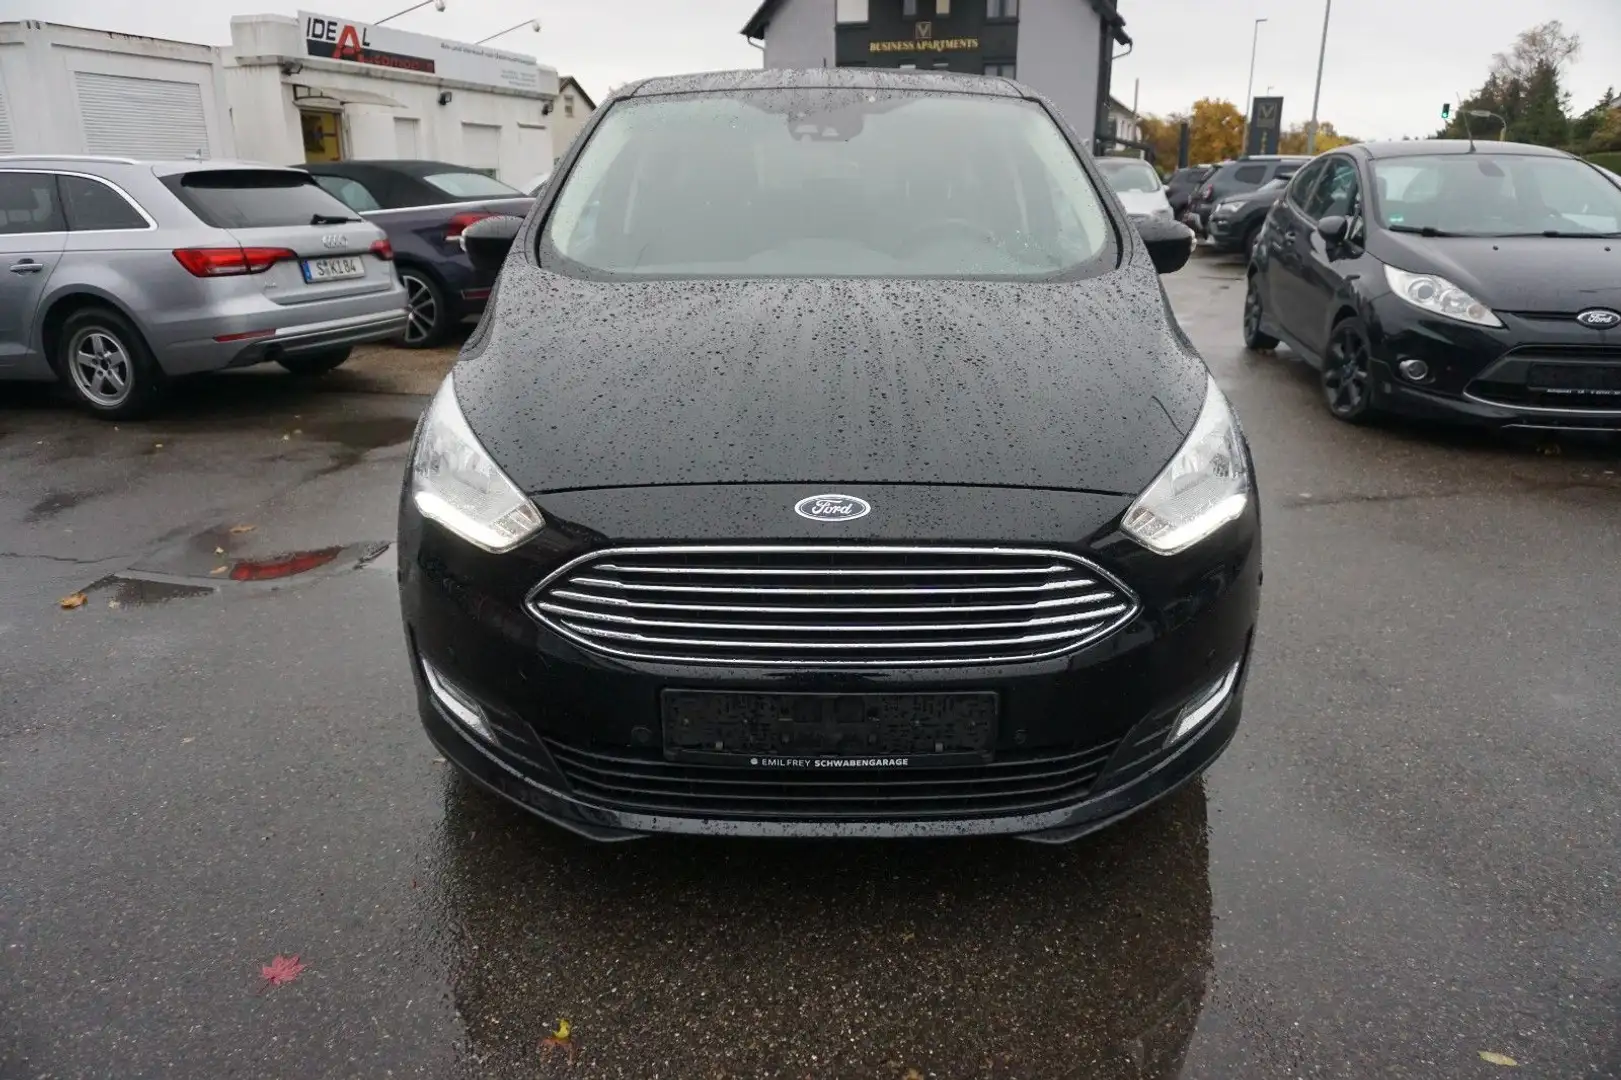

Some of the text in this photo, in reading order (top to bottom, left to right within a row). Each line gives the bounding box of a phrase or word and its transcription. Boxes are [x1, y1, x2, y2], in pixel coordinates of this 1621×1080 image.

[306, 17, 370, 62] IDEAL
[870, 39, 978, 52] BUSINESS APARTMENTS
[1588, 313, 1612, 323] Ford
[811, 499, 853, 515] Ford
[761, 758, 909, 767] EMIL FREY SCHWABENGARAGE
